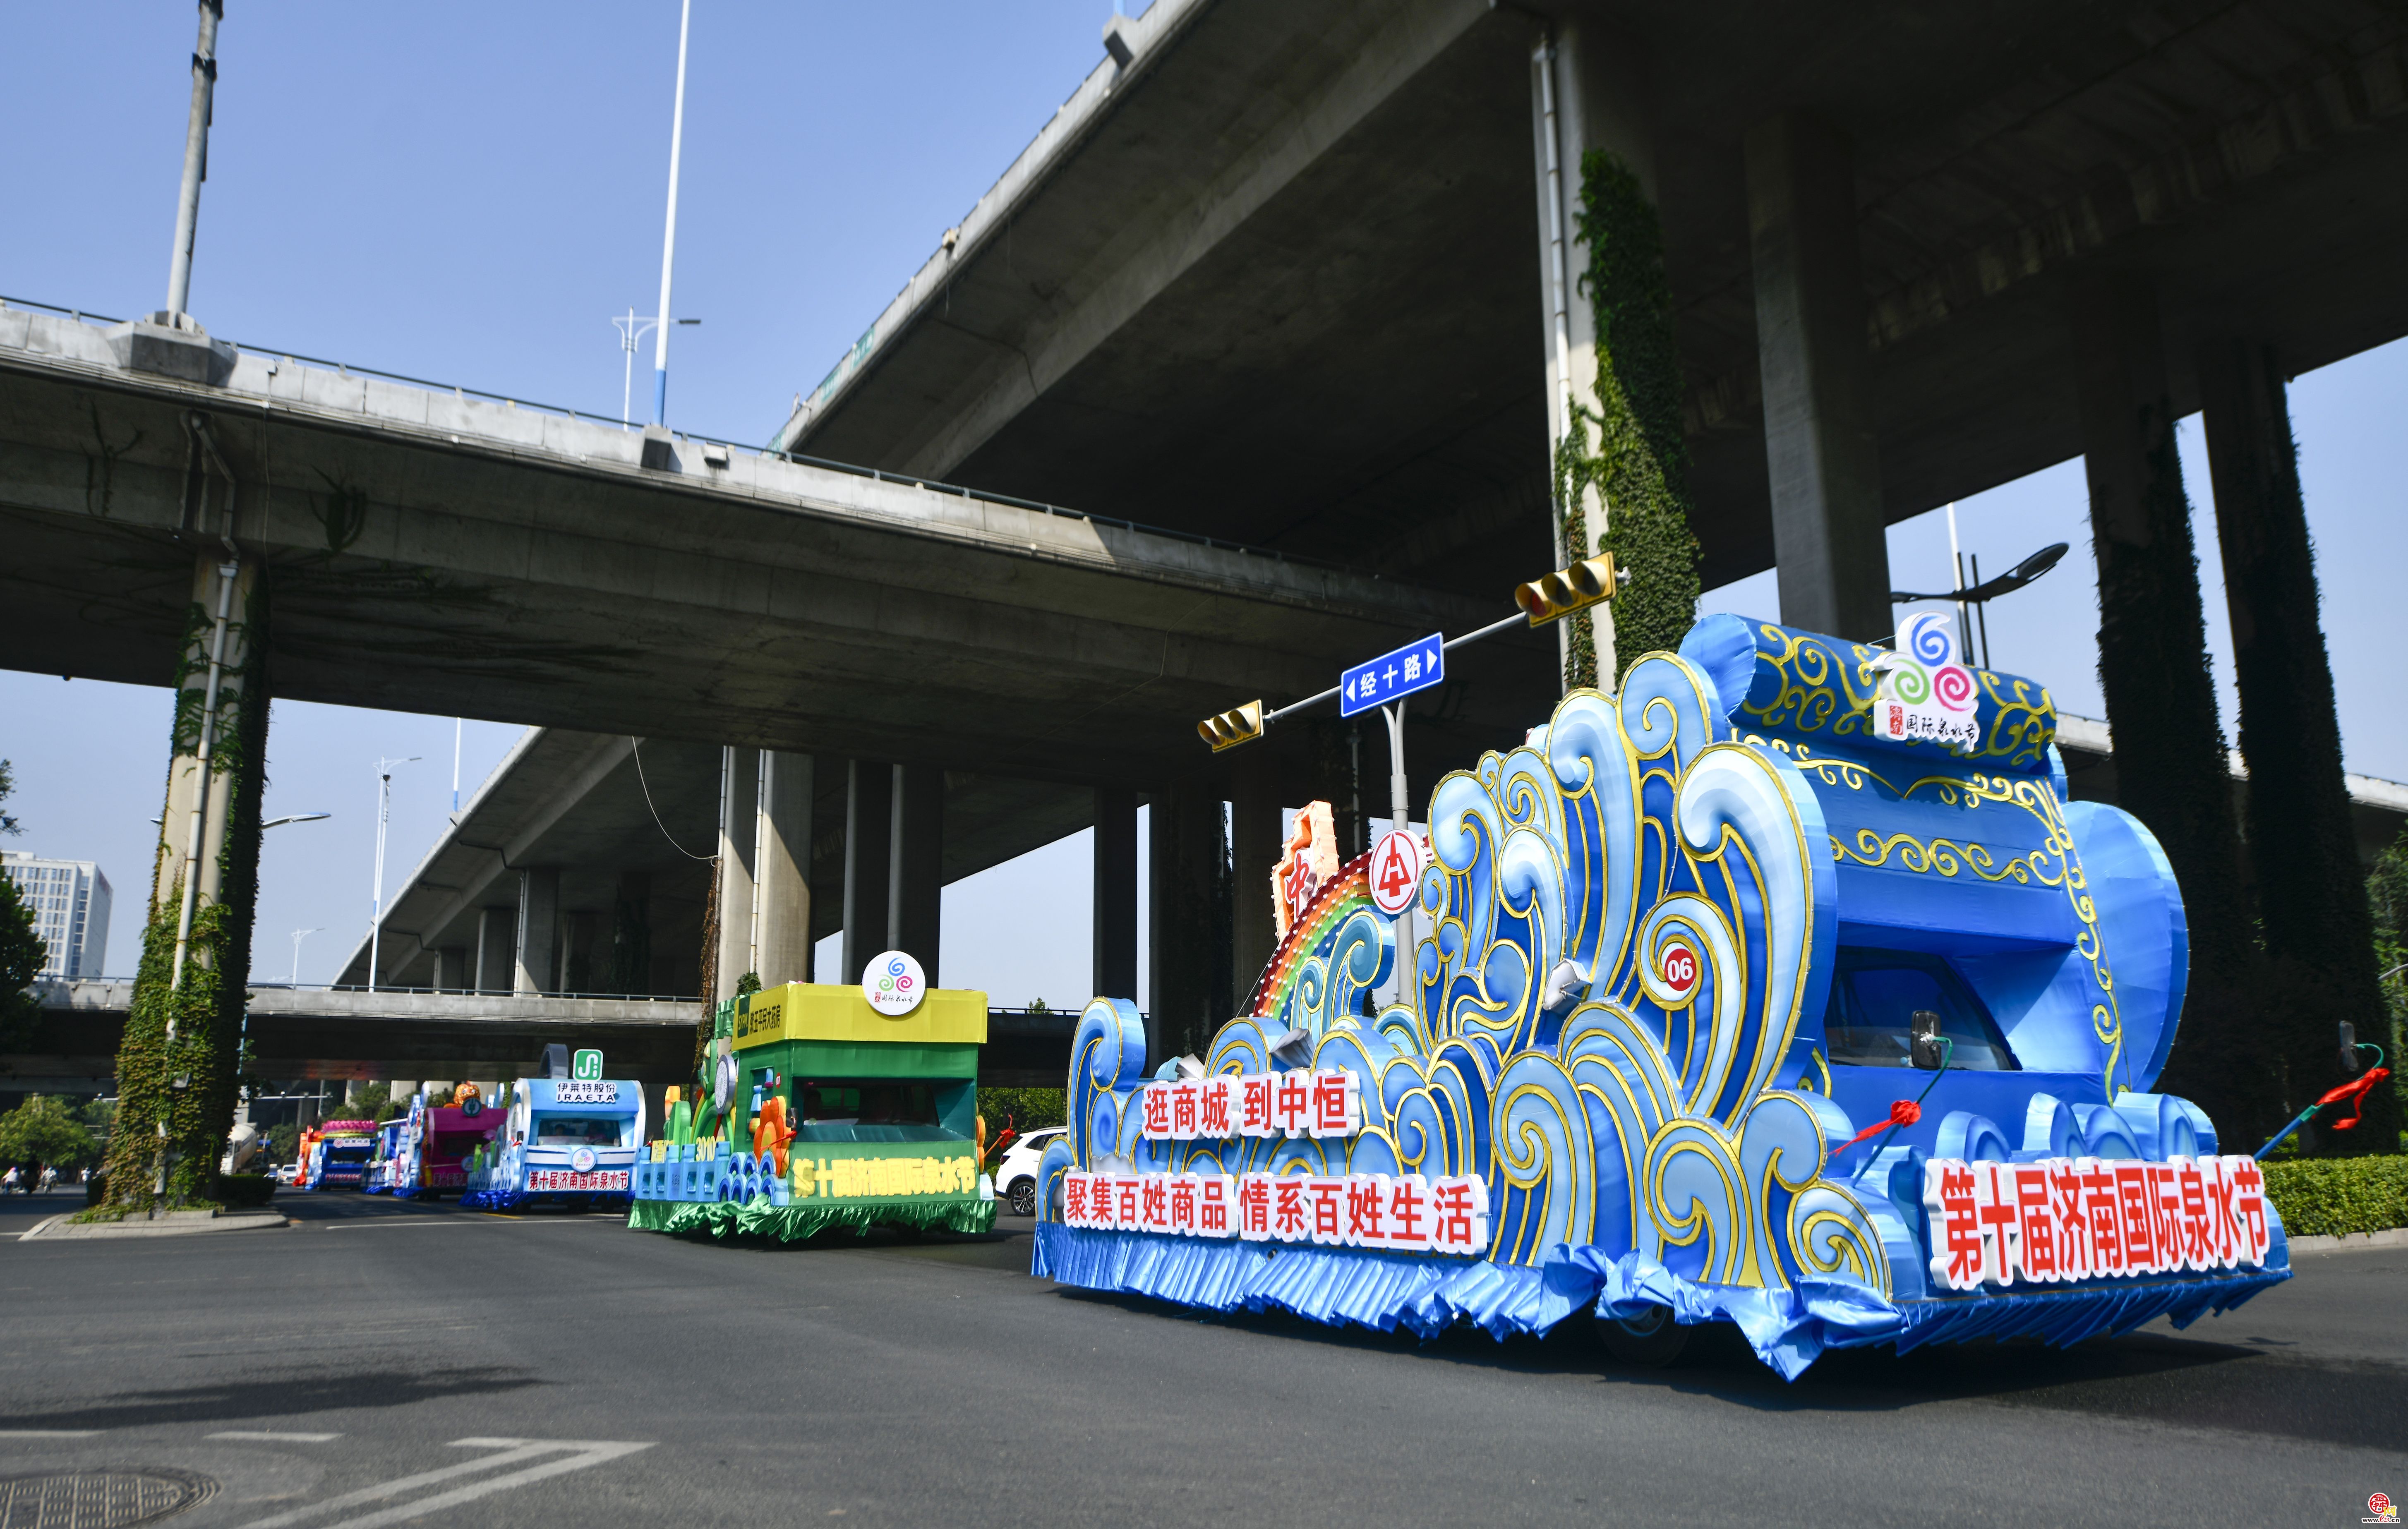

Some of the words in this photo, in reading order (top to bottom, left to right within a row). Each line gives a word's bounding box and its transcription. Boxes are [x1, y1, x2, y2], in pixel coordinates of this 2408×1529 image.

[1361, 654, 1421, 698] 经十路
[1668, 957, 1693, 982] 06
[558, 1083, 615, 1093] 伊莱特股份
[1146, 1083, 1228, 1132] 逛商城
[1245, 1077, 1346, 1130] 到中恒
[530, 1171, 628, 1189] 第十届济南国际泉水节
[792, 1157, 976, 1198] 第十届济南国际泉水节
[1067, 1179, 1226, 1229] 聚集百姓商品
[1240, 1180, 1473, 1244] 情系百姓生活
[1941, 1163, 2265, 1281] 第十届济南国际泉水节
